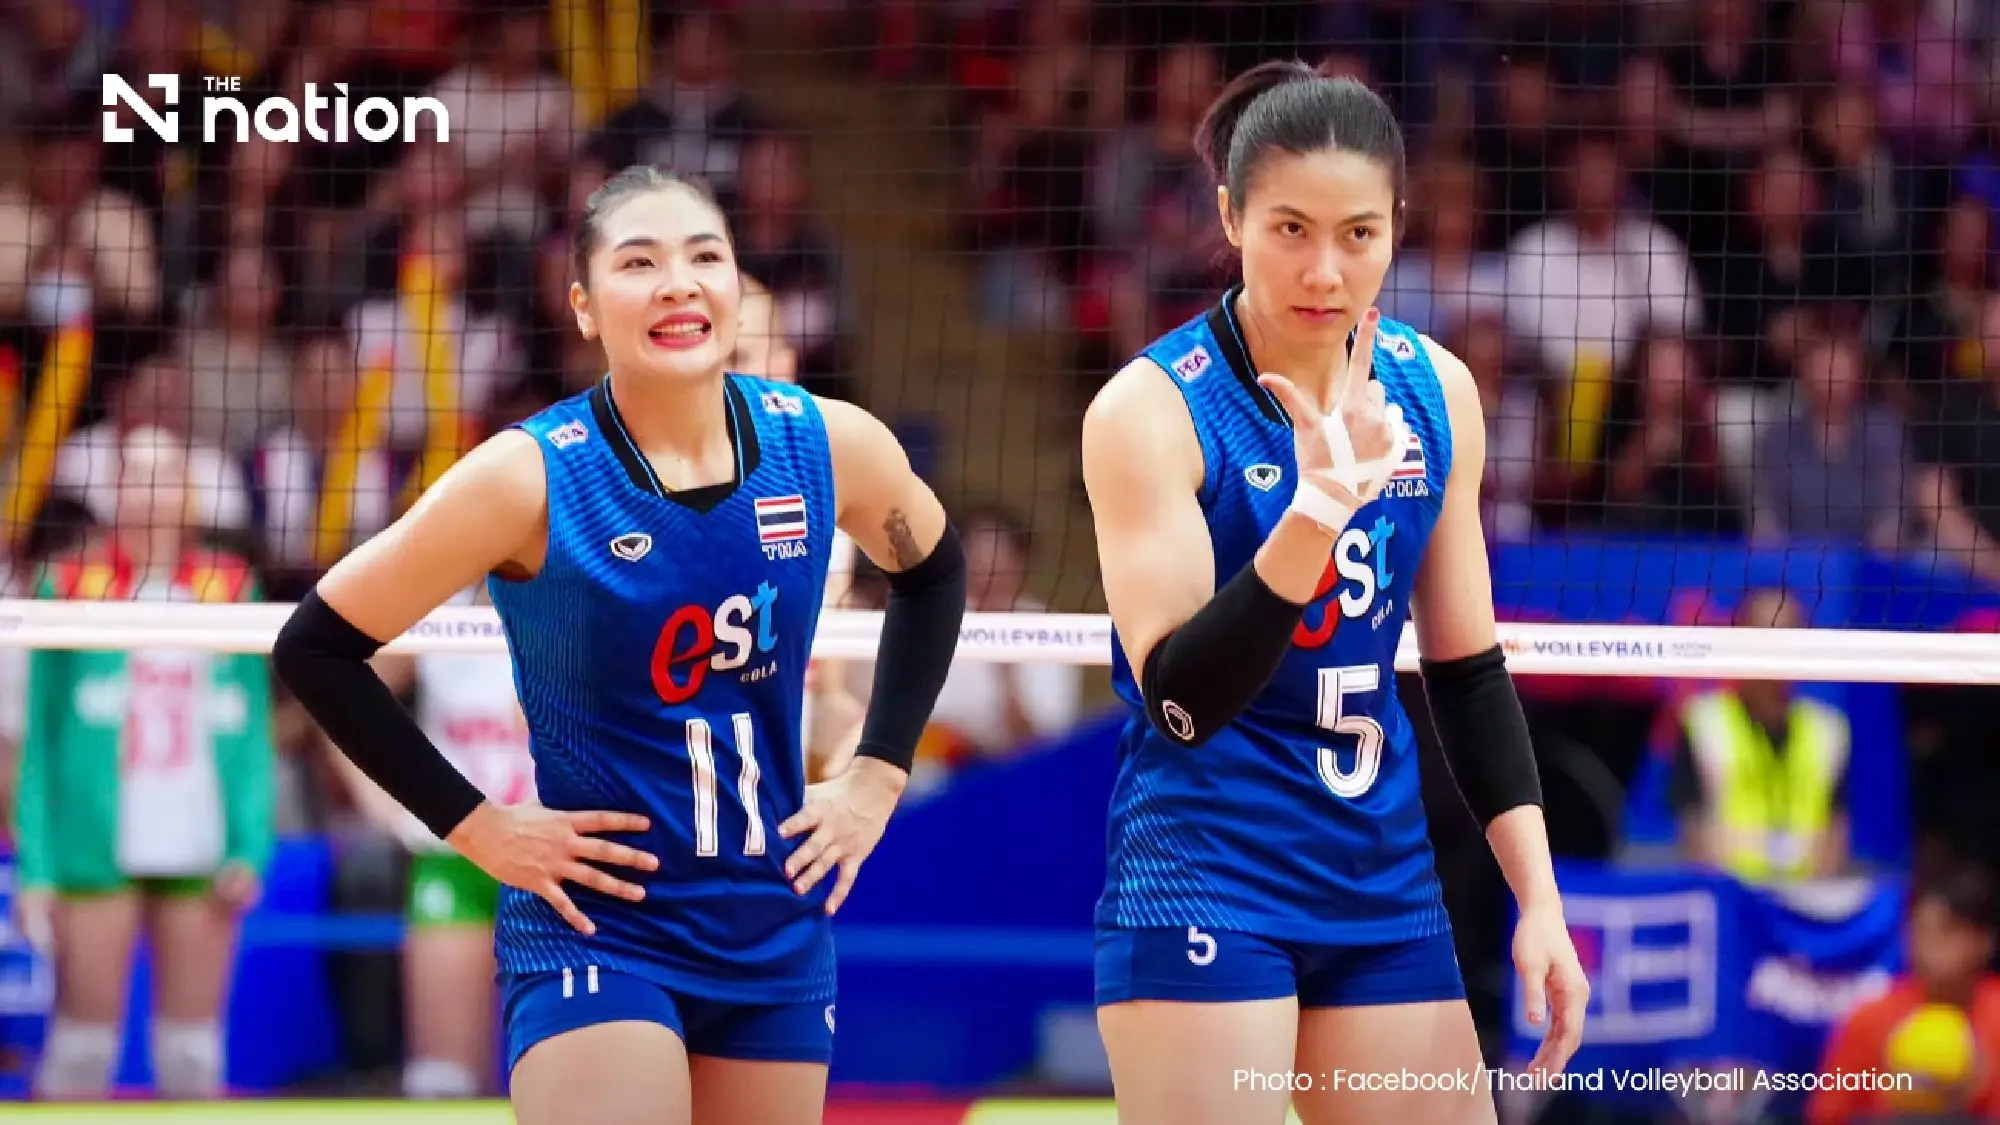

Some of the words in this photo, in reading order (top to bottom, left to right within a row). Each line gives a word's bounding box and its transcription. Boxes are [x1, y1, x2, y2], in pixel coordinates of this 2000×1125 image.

[1384, 479, 1430, 499] THA
[761, 540, 808, 561] THA
[651, 580, 778, 705] est
[958, 627, 1084, 648] VOLLEYBALL
[1533, 640, 1664, 658] VOLLEYBALL
[739, 659, 778, 684] COLA
[1315, 662, 1385, 799] 5
[685, 712, 766, 858] 11
[1186, 925, 1218, 966] 5
